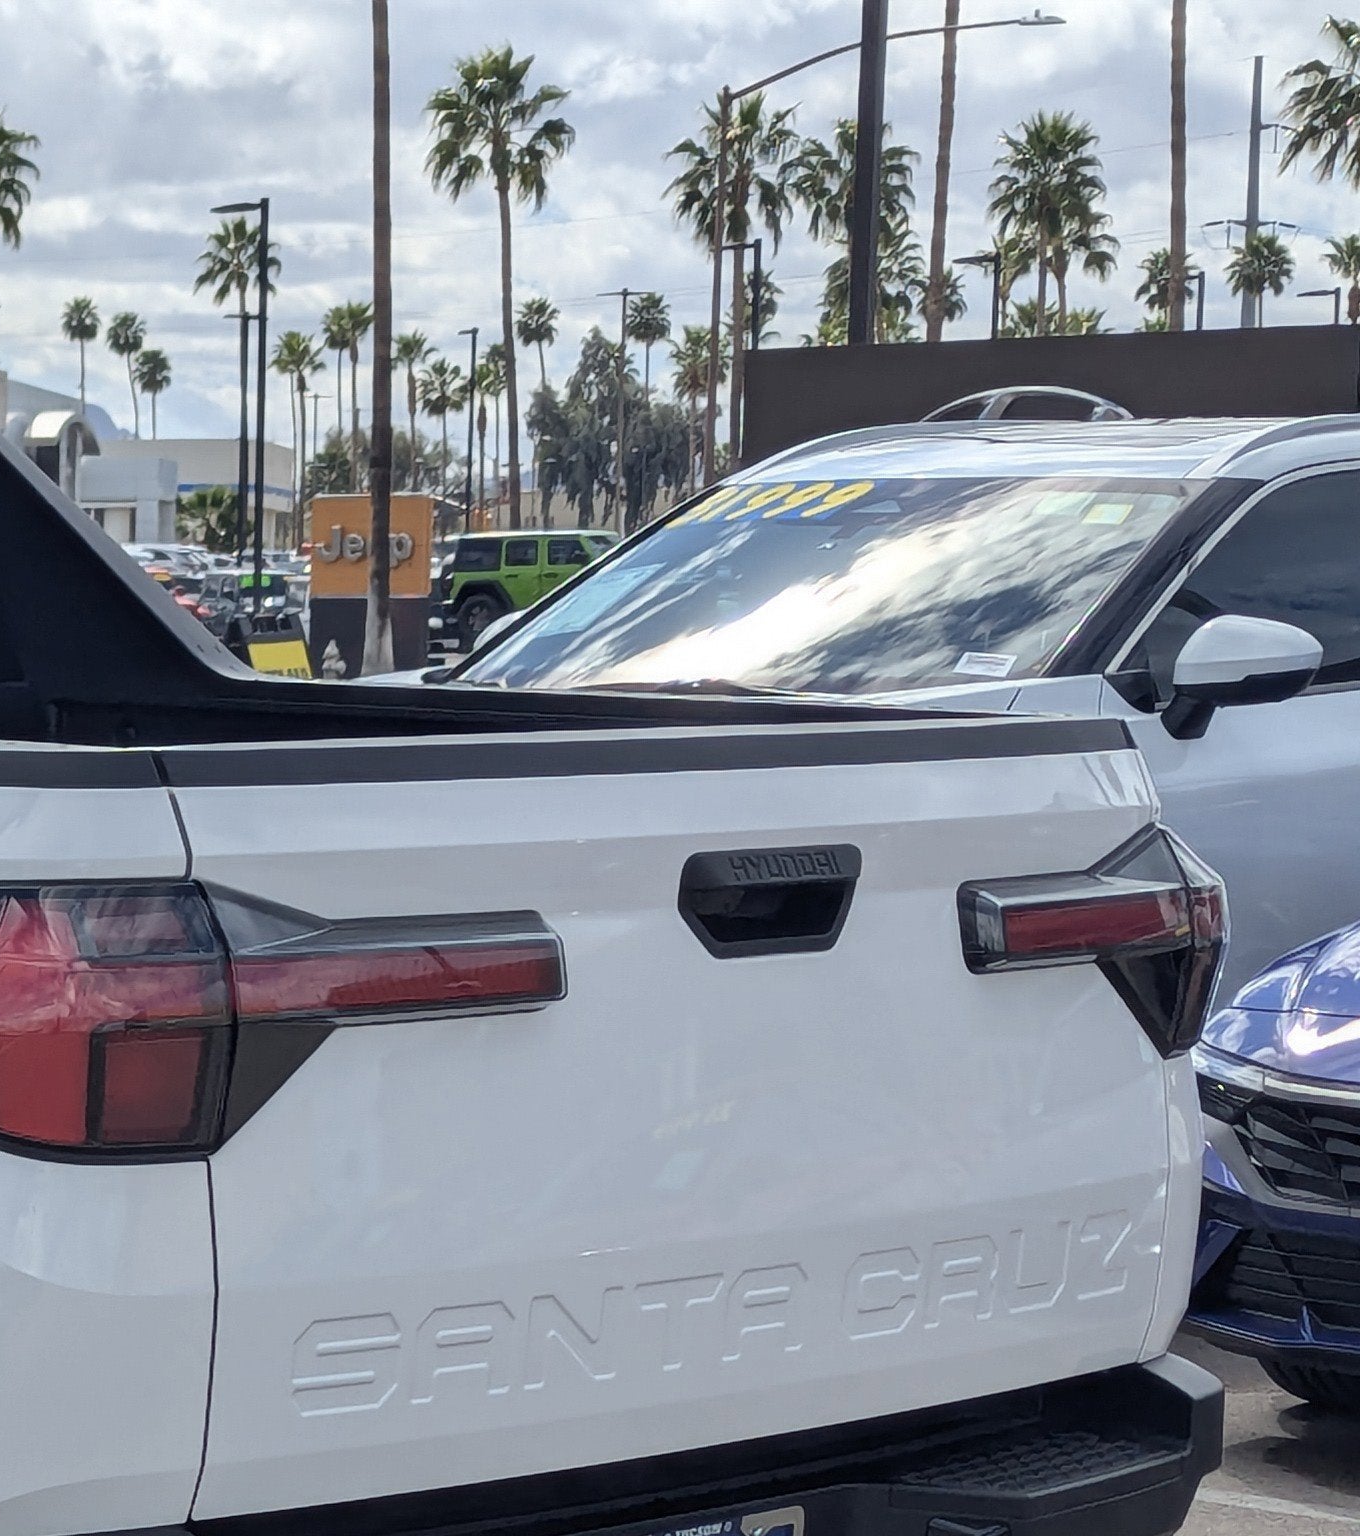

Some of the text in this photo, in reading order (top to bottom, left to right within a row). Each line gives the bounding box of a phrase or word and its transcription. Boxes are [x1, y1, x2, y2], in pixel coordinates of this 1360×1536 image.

[314, 524, 413, 568] Jep
[729, 851, 841, 881] HYUNDAI
[291, 1207, 1133, 1417] SANTA CRUZ
